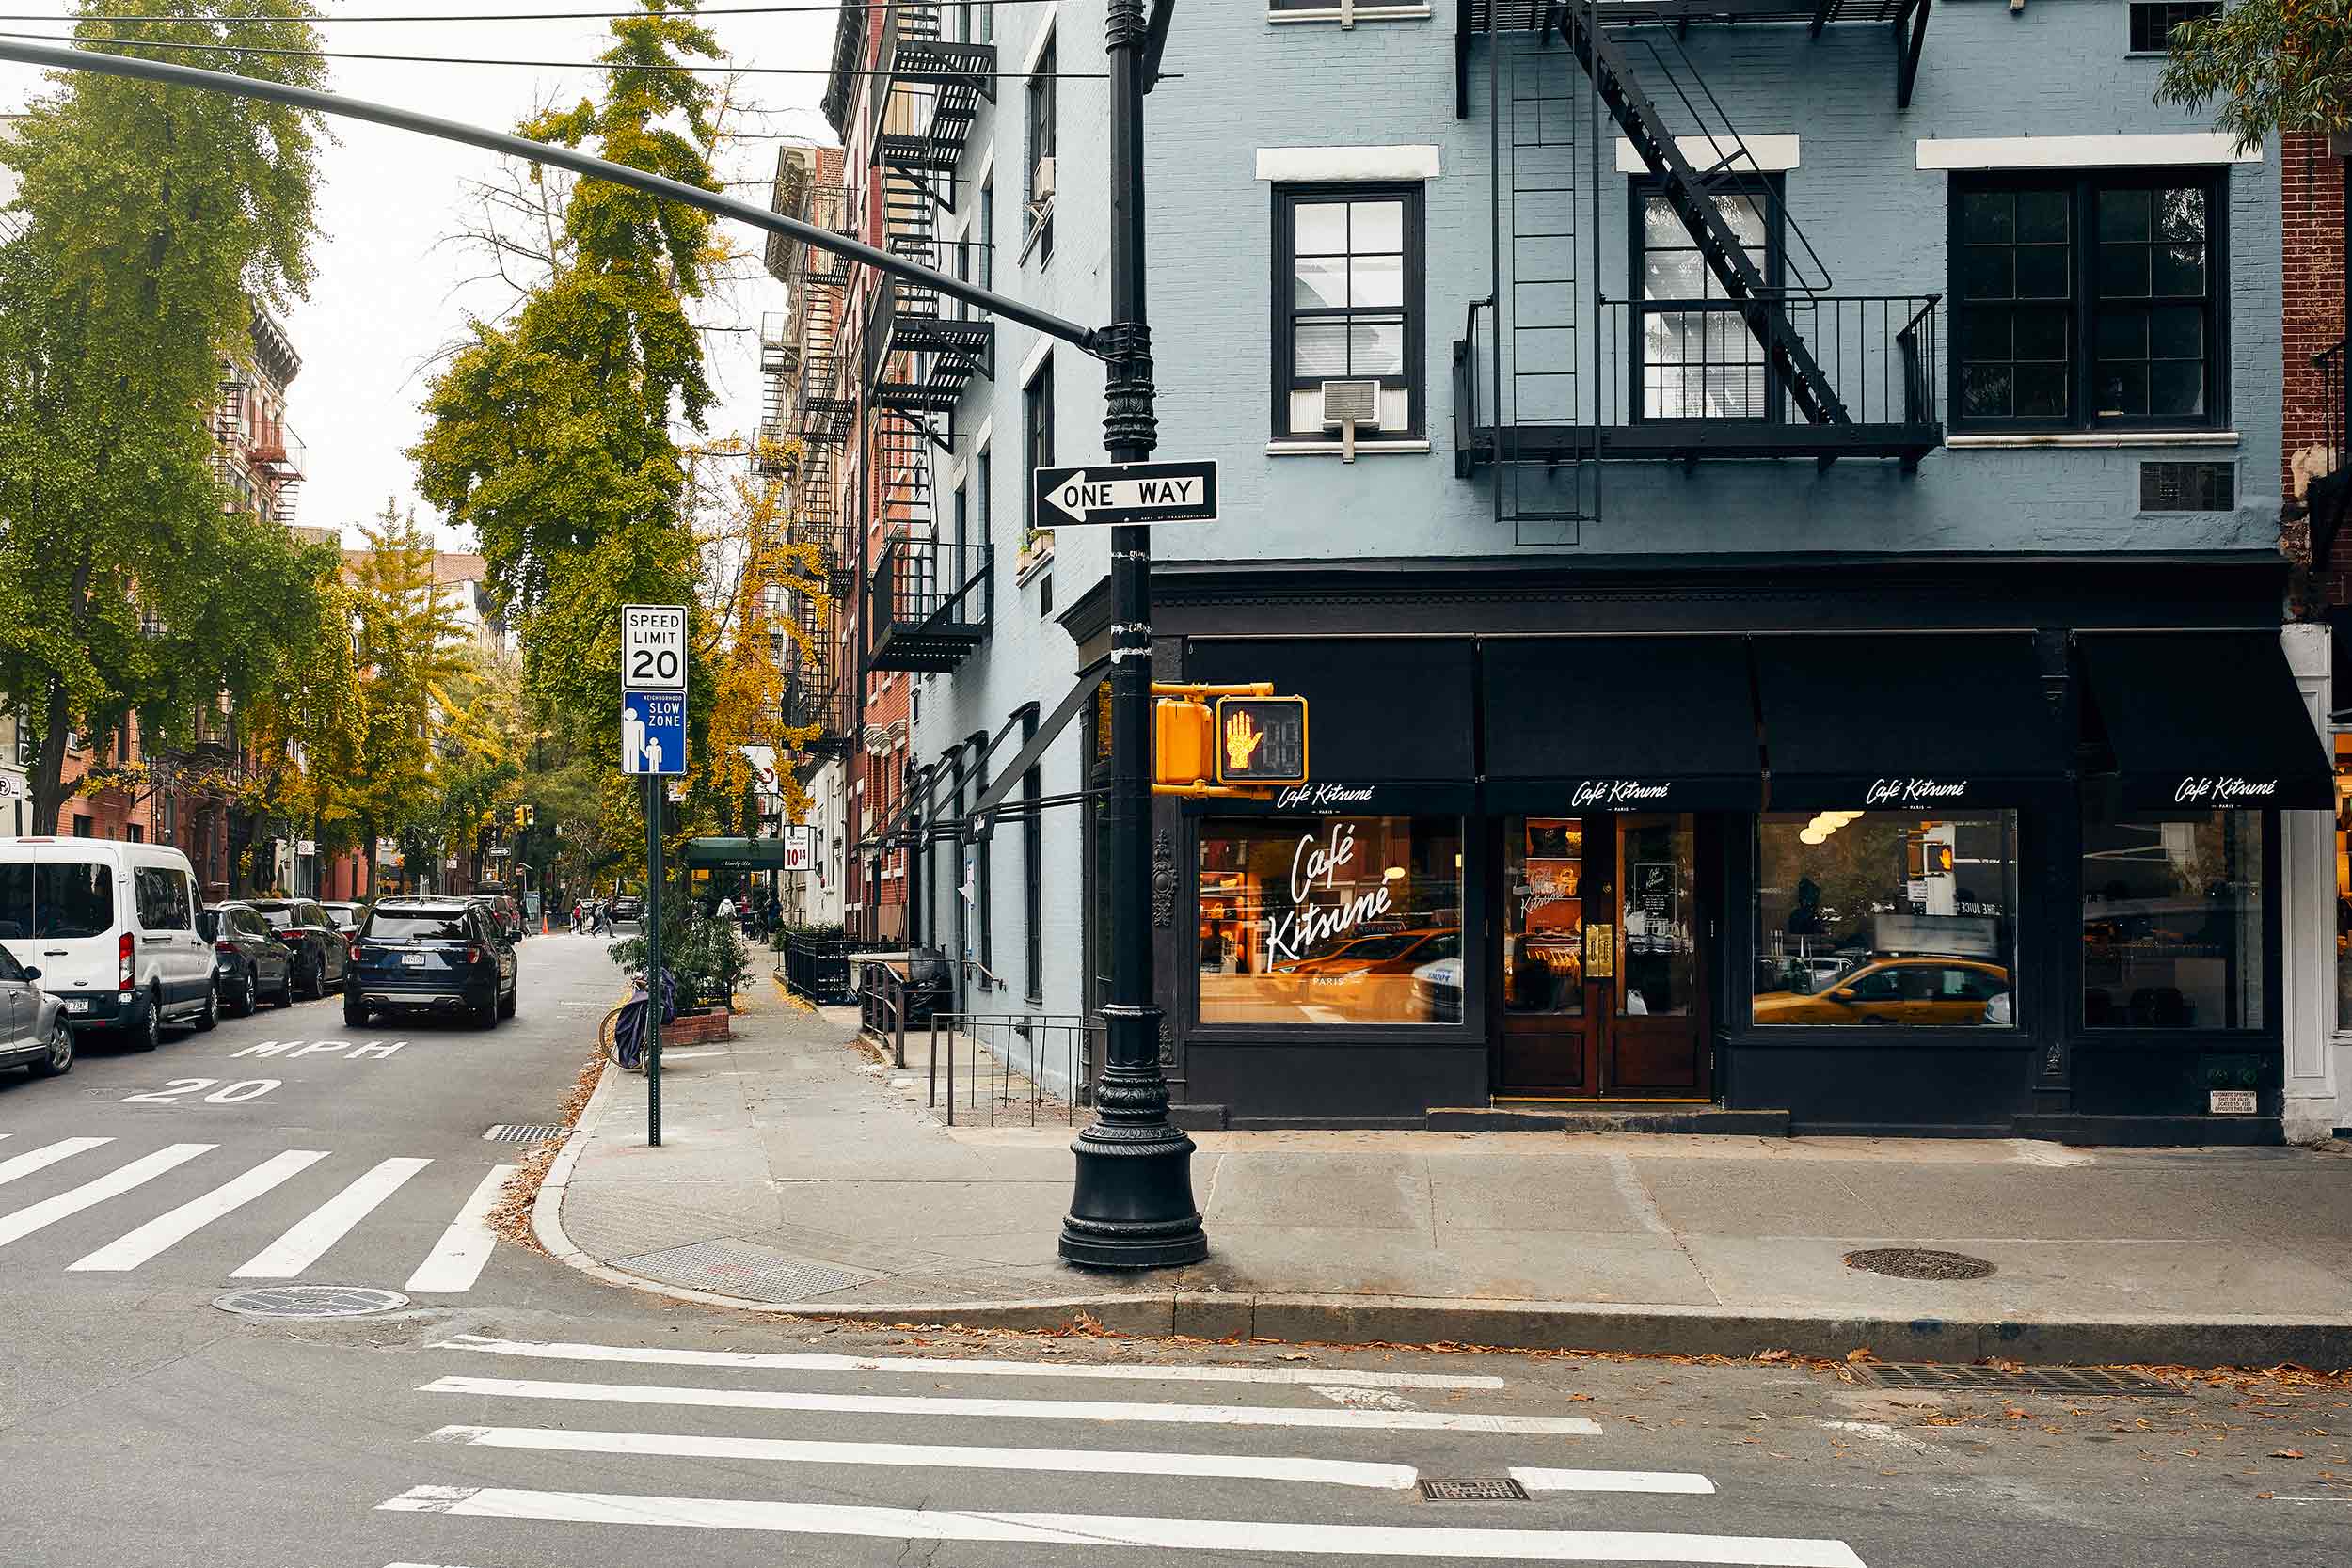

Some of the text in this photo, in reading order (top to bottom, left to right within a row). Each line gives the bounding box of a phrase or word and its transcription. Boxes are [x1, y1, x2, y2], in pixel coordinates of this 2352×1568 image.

[1063, 481, 1193, 509] ONE WAY
[629, 614, 680, 627] SPEED
[633, 631, 676, 644] LIMIT
[632, 650, 679, 679] 20
[648, 715, 681, 727] ZONE
[649, 702, 680, 715] SLOW
[1277, 783, 1375, 809] Café Kitsuné
[1571, 780, 1671, 807] Café Kitsuné
[1866, 777, 1967, 805] Café Kitsuné
[2174, 776, 2278, 802] Café Kitsuné
[787, 848, 799, 866] 10
[1291, 823, 1355, 904] Café
[1265, 877, 1392, 974] Kitsuné
[1312, 977, 1343, 986] PARIS
[229, 1040, 408, 1059] MPH
[119, 1078, 282, 1103] 20
